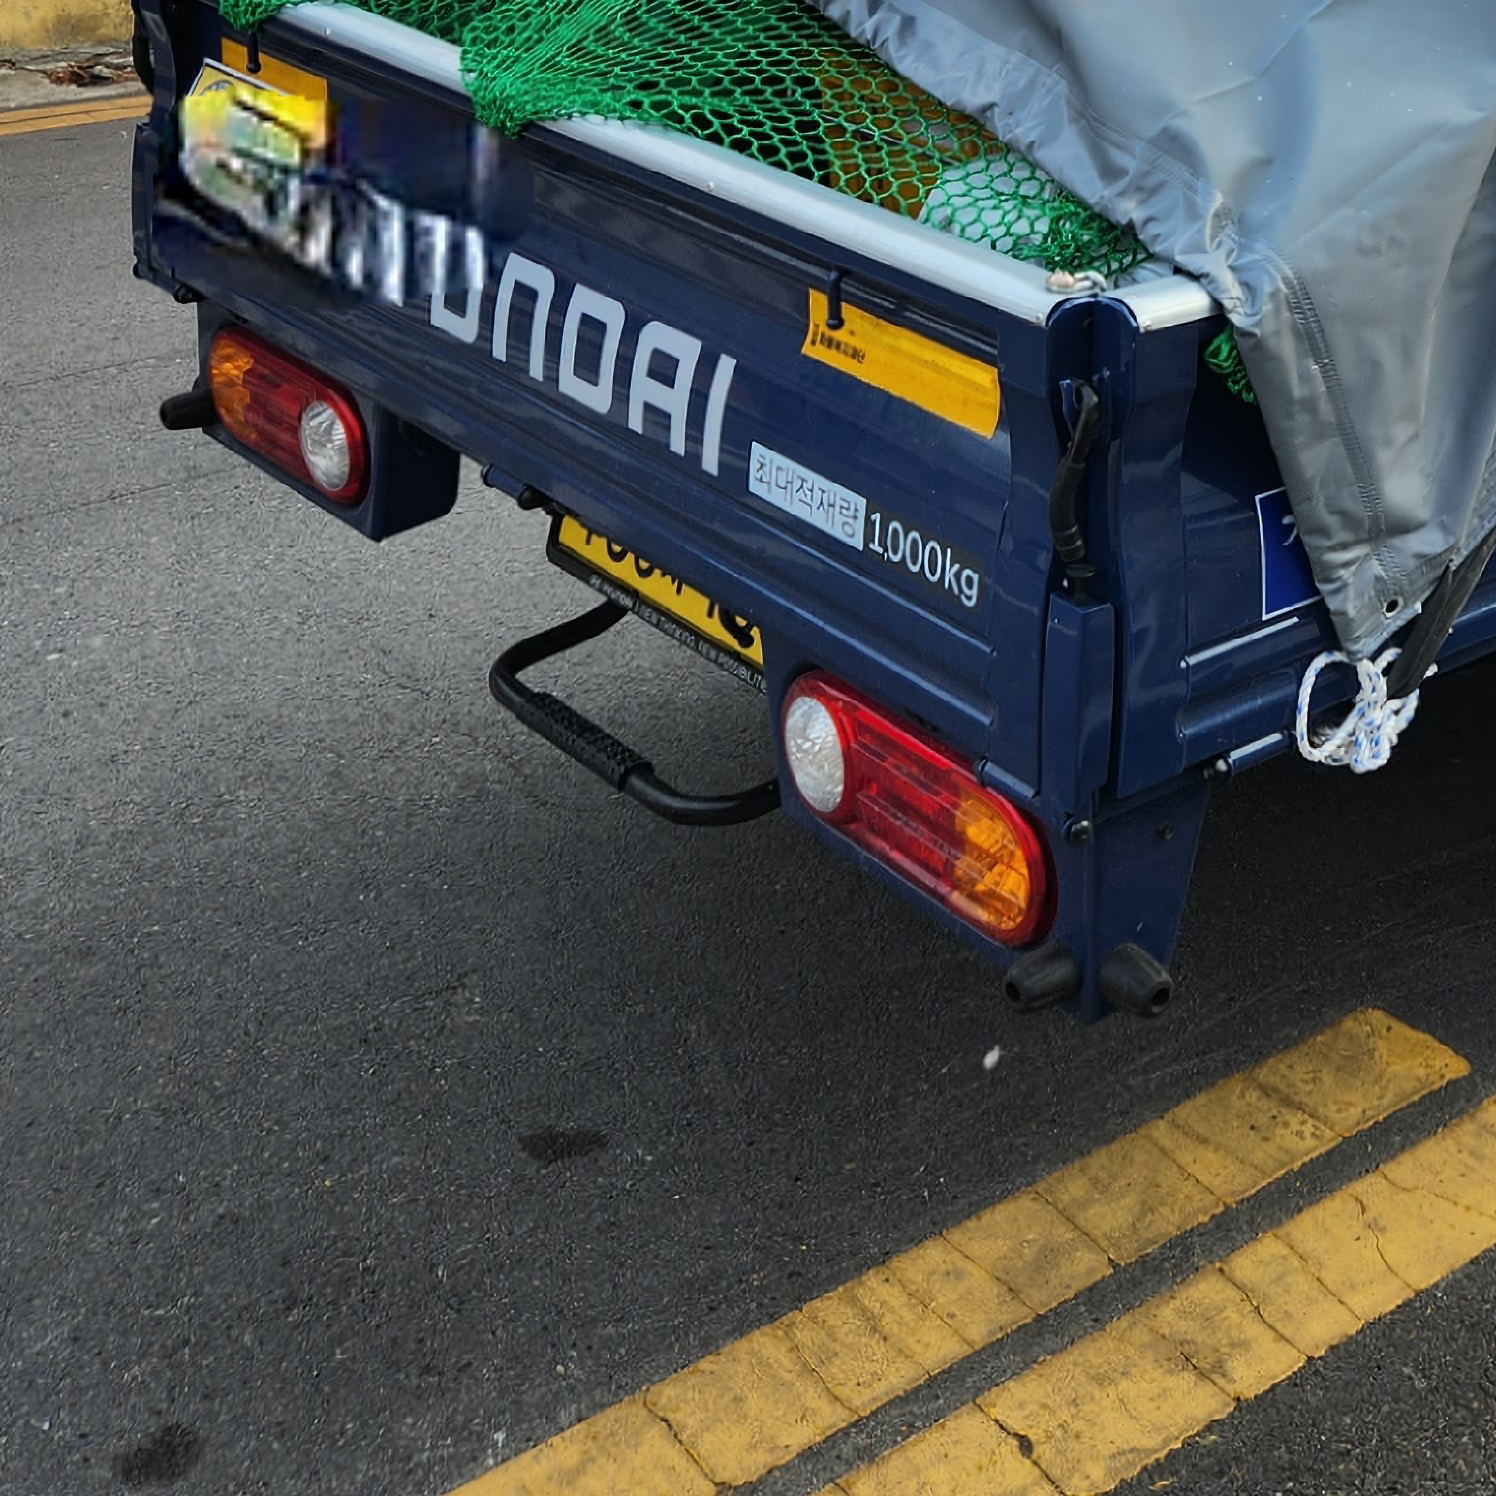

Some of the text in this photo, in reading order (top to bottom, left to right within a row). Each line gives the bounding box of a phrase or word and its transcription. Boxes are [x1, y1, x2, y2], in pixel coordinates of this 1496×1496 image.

[325, 172, 738, 478] UNDAI
[754, 453, 860, 541] 최대적재량
[868, 511, 980, 608] 1,000kg
